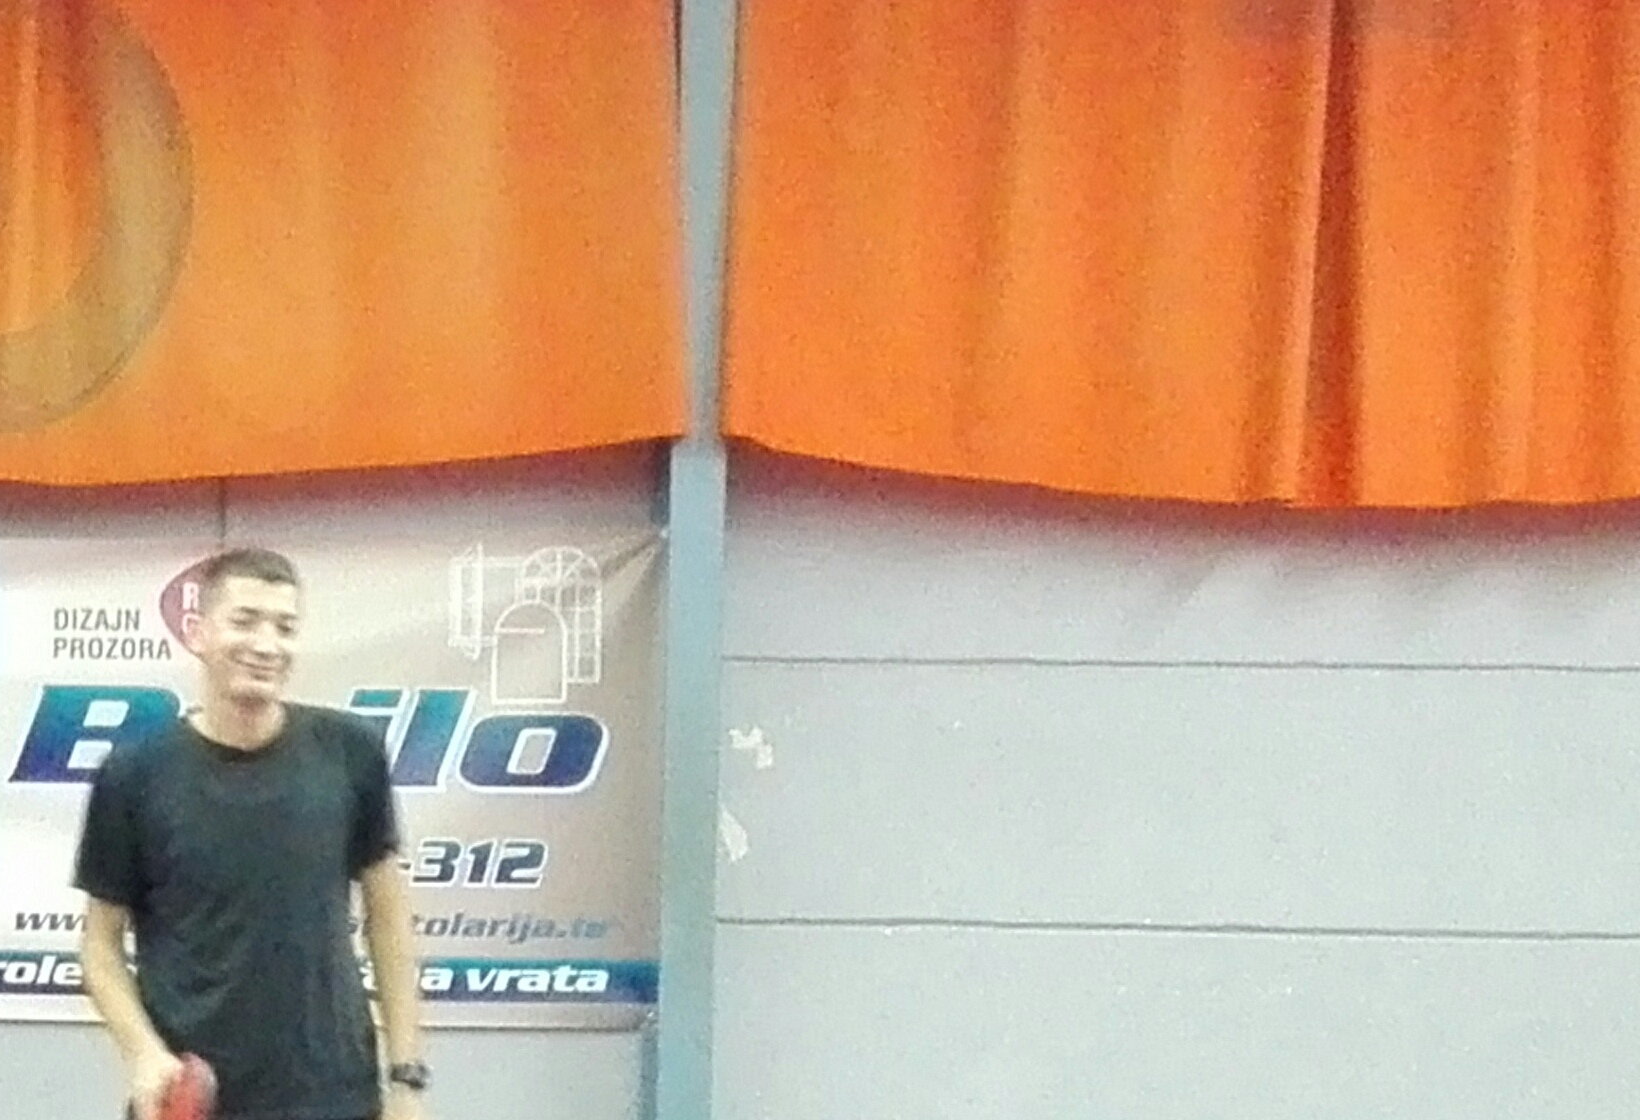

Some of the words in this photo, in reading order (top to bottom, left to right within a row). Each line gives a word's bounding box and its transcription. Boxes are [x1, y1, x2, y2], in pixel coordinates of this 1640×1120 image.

[54, 607, 140, 632] DIZAJN
[53, 637, 172, 660] PROZORA
[466, 965, 609, 992] vrata
